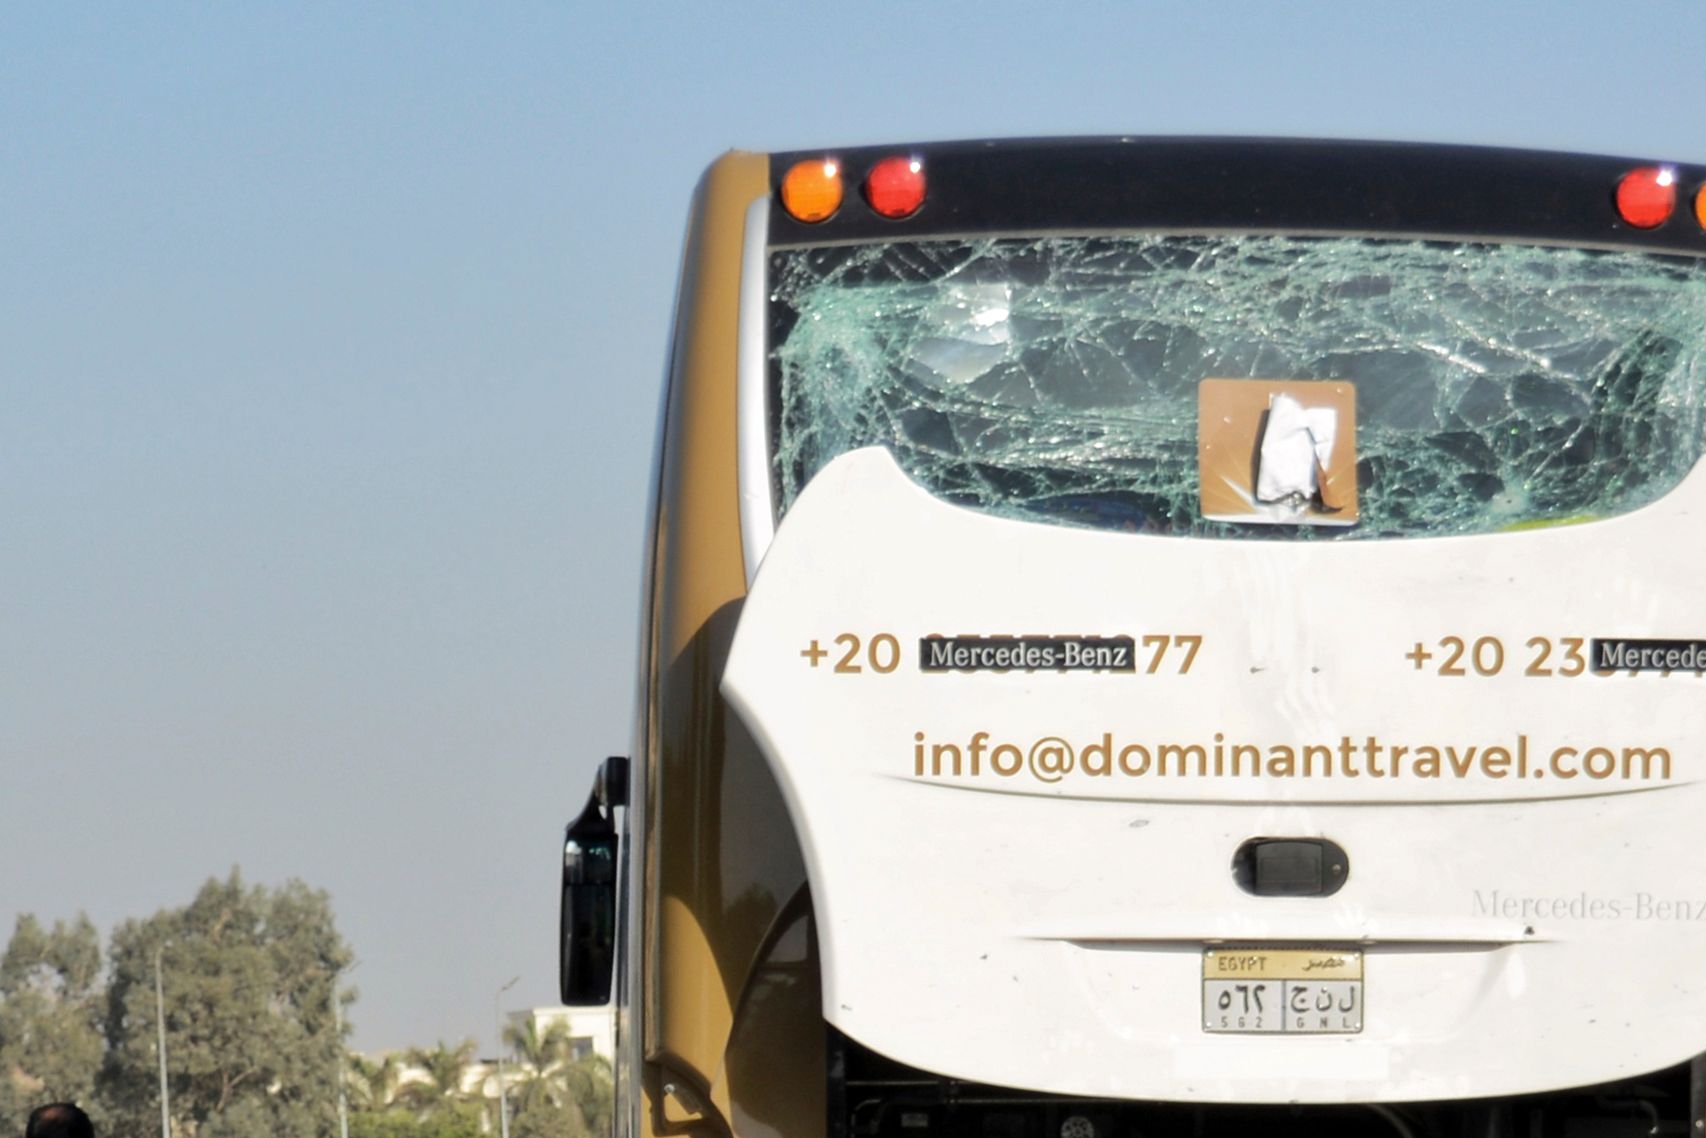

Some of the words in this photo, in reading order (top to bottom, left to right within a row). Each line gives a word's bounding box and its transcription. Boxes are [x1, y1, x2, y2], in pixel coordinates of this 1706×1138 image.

[801, 633, 901, 673] +20
[929, 642, 1127, 667] Mercedes-Benz
[1406, 636, 1504, 676] +20
[914, 732, 1673, 782] info@dominanttravel.com
[1218, 956, 1267, 972] EGYPT
